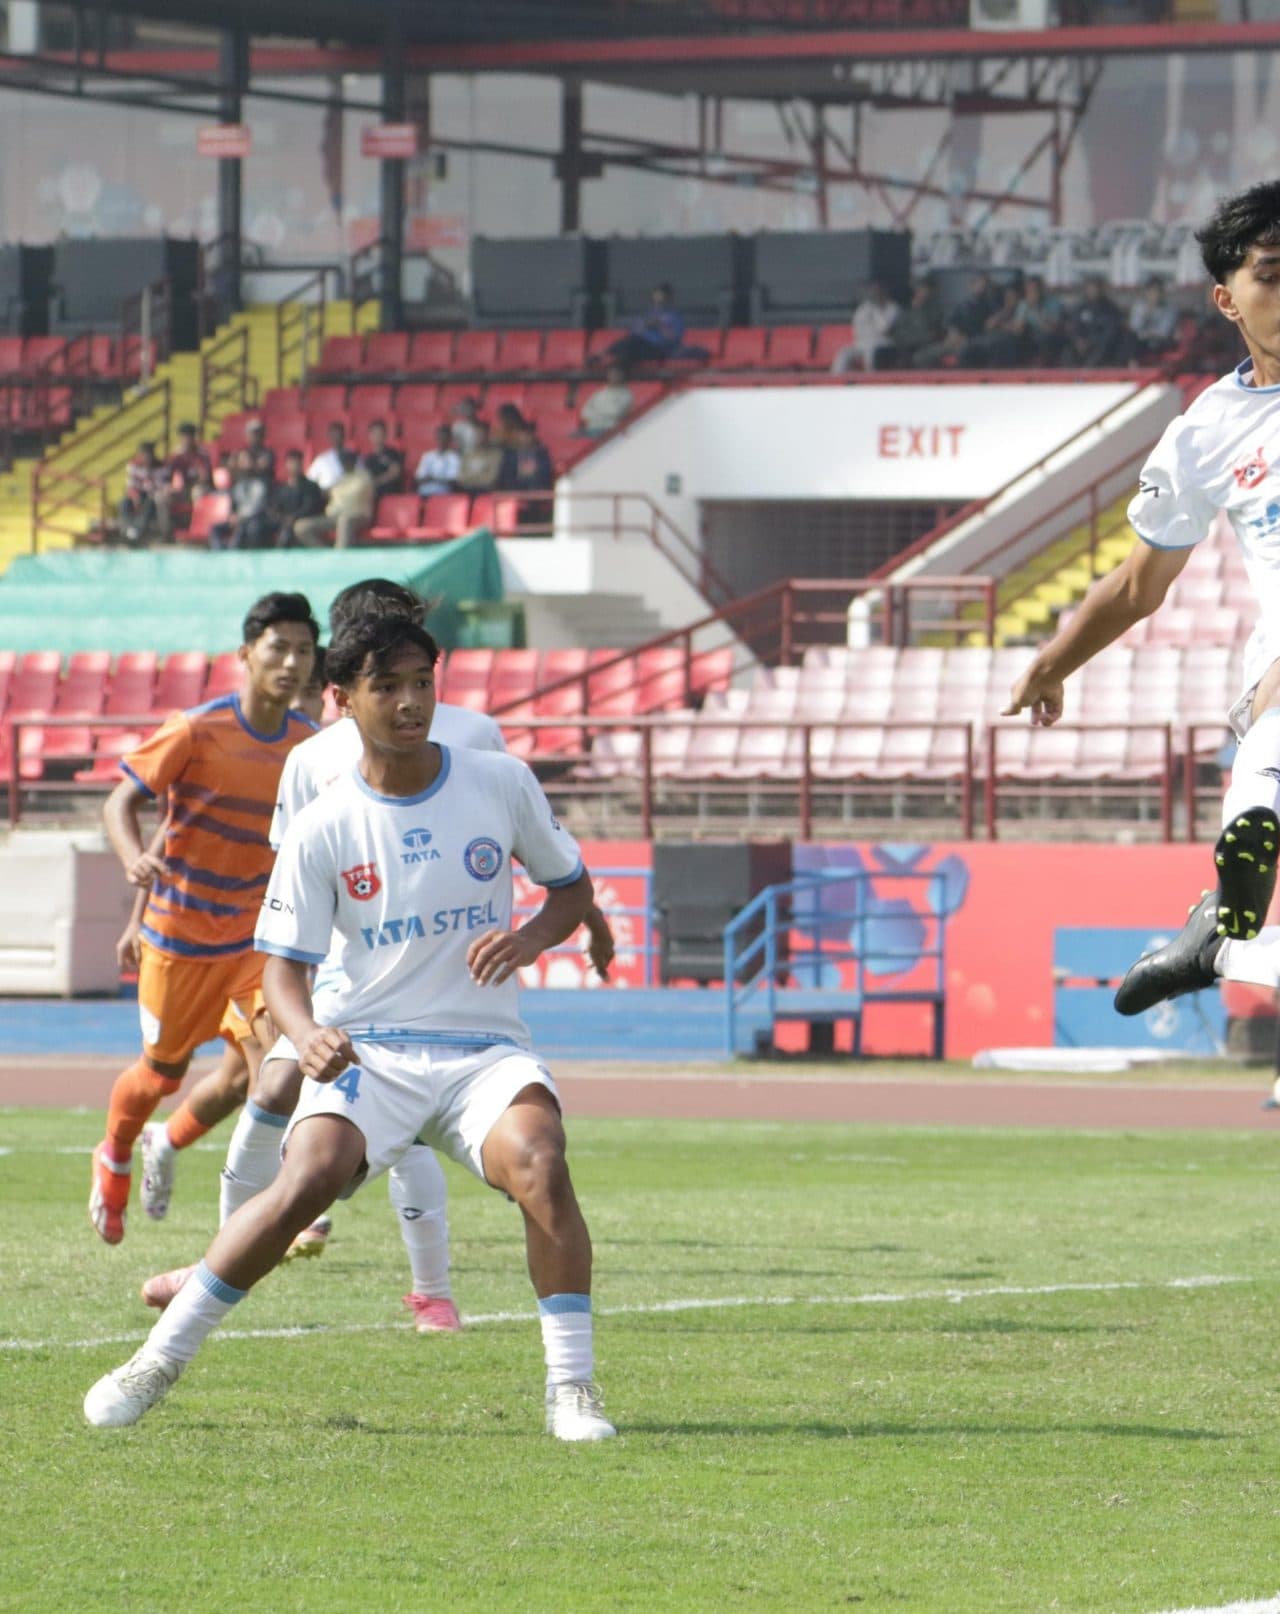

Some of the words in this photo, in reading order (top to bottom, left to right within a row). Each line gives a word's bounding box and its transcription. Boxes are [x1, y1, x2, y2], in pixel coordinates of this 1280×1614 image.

[878, 424, 967, 459] EXIT
[400, 849, 441, 864] TATA
[263, 896, 295, 915] ON
[360, 915, 426, 950] TATA
[334, 1067, 361, 1104] 4
